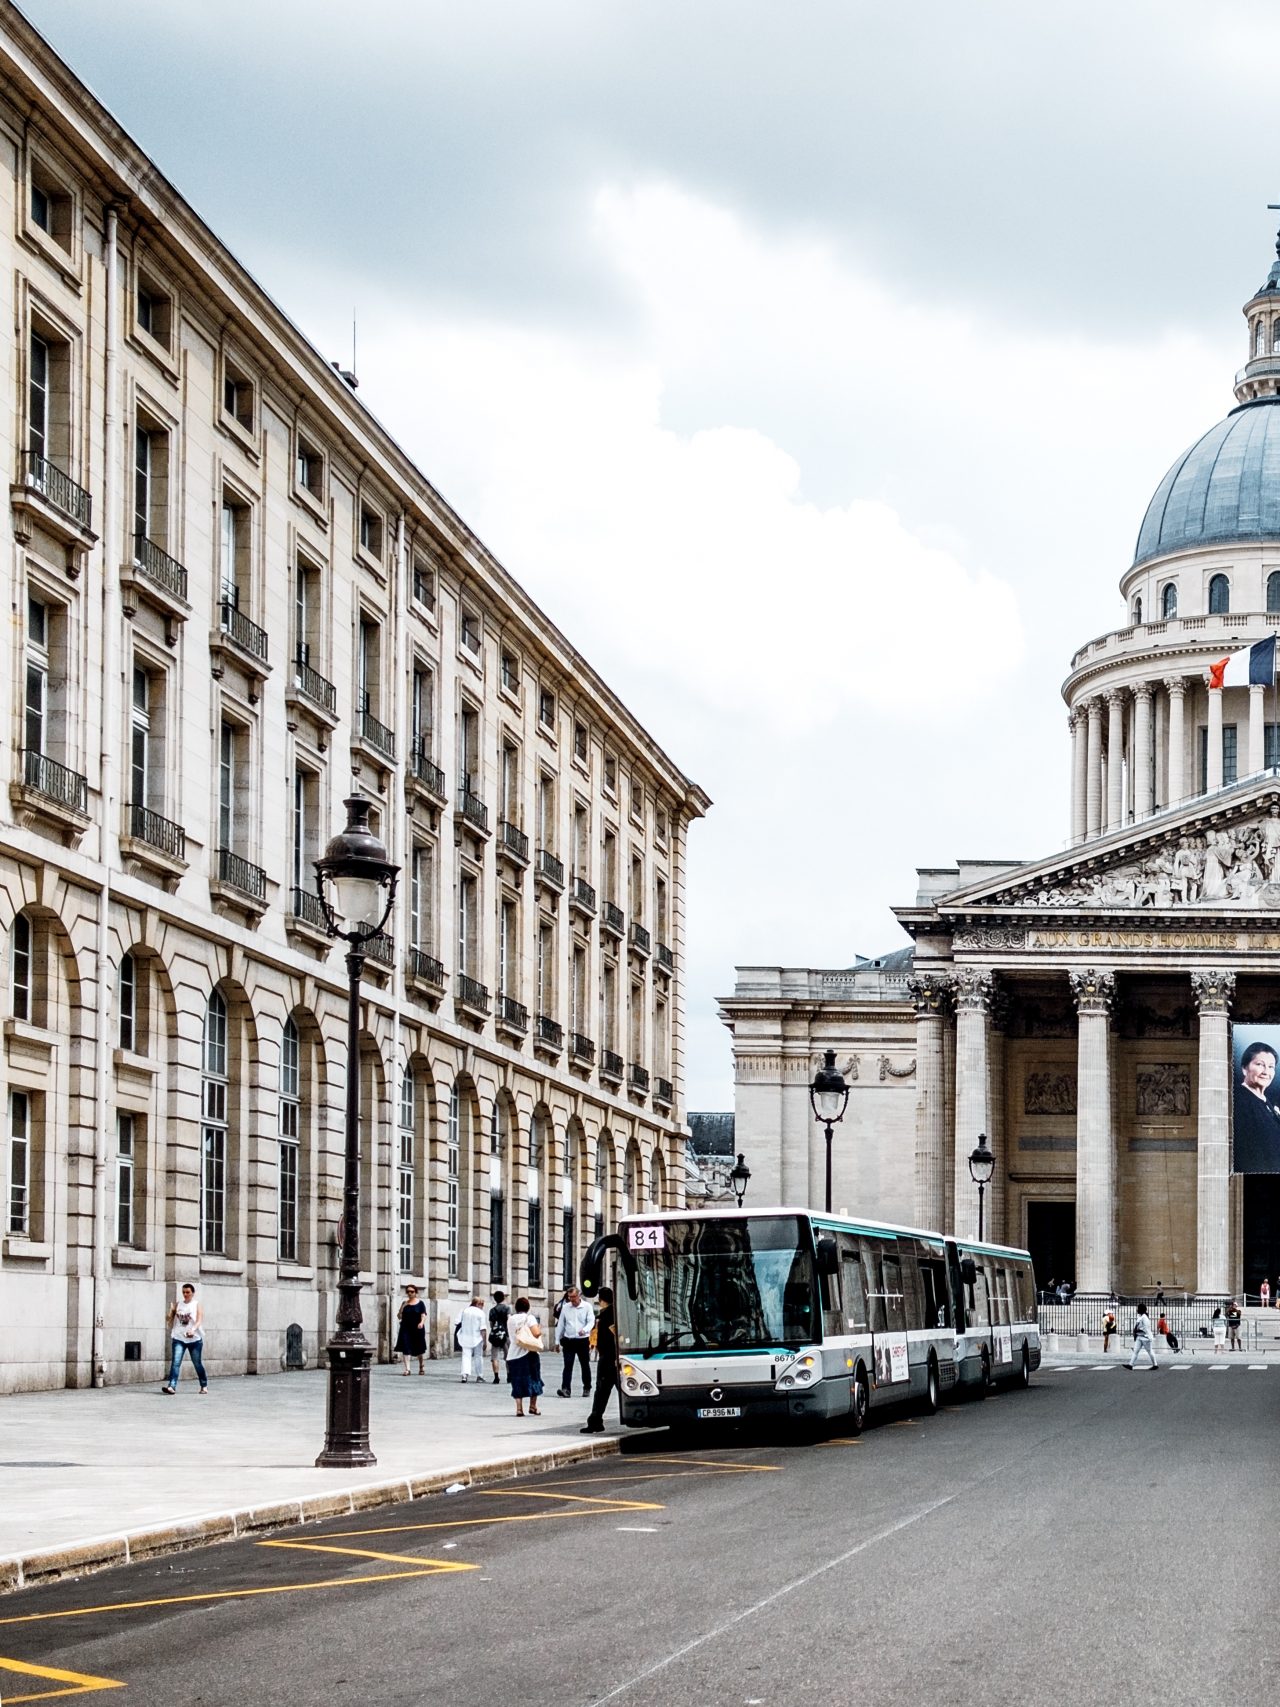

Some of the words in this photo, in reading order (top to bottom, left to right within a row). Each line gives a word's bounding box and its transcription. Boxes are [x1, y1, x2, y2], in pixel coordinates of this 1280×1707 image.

[1032, 932, 1072, 948] AUX
[1077, 932, 1154, 948] GRANDS
[1156, 933, 1238, 949] HOMMES
[1247, 934, 1271, 949] LA
[635, 1229, 658, 1246] 84
[774, 1354, 796, 1363] 8679
